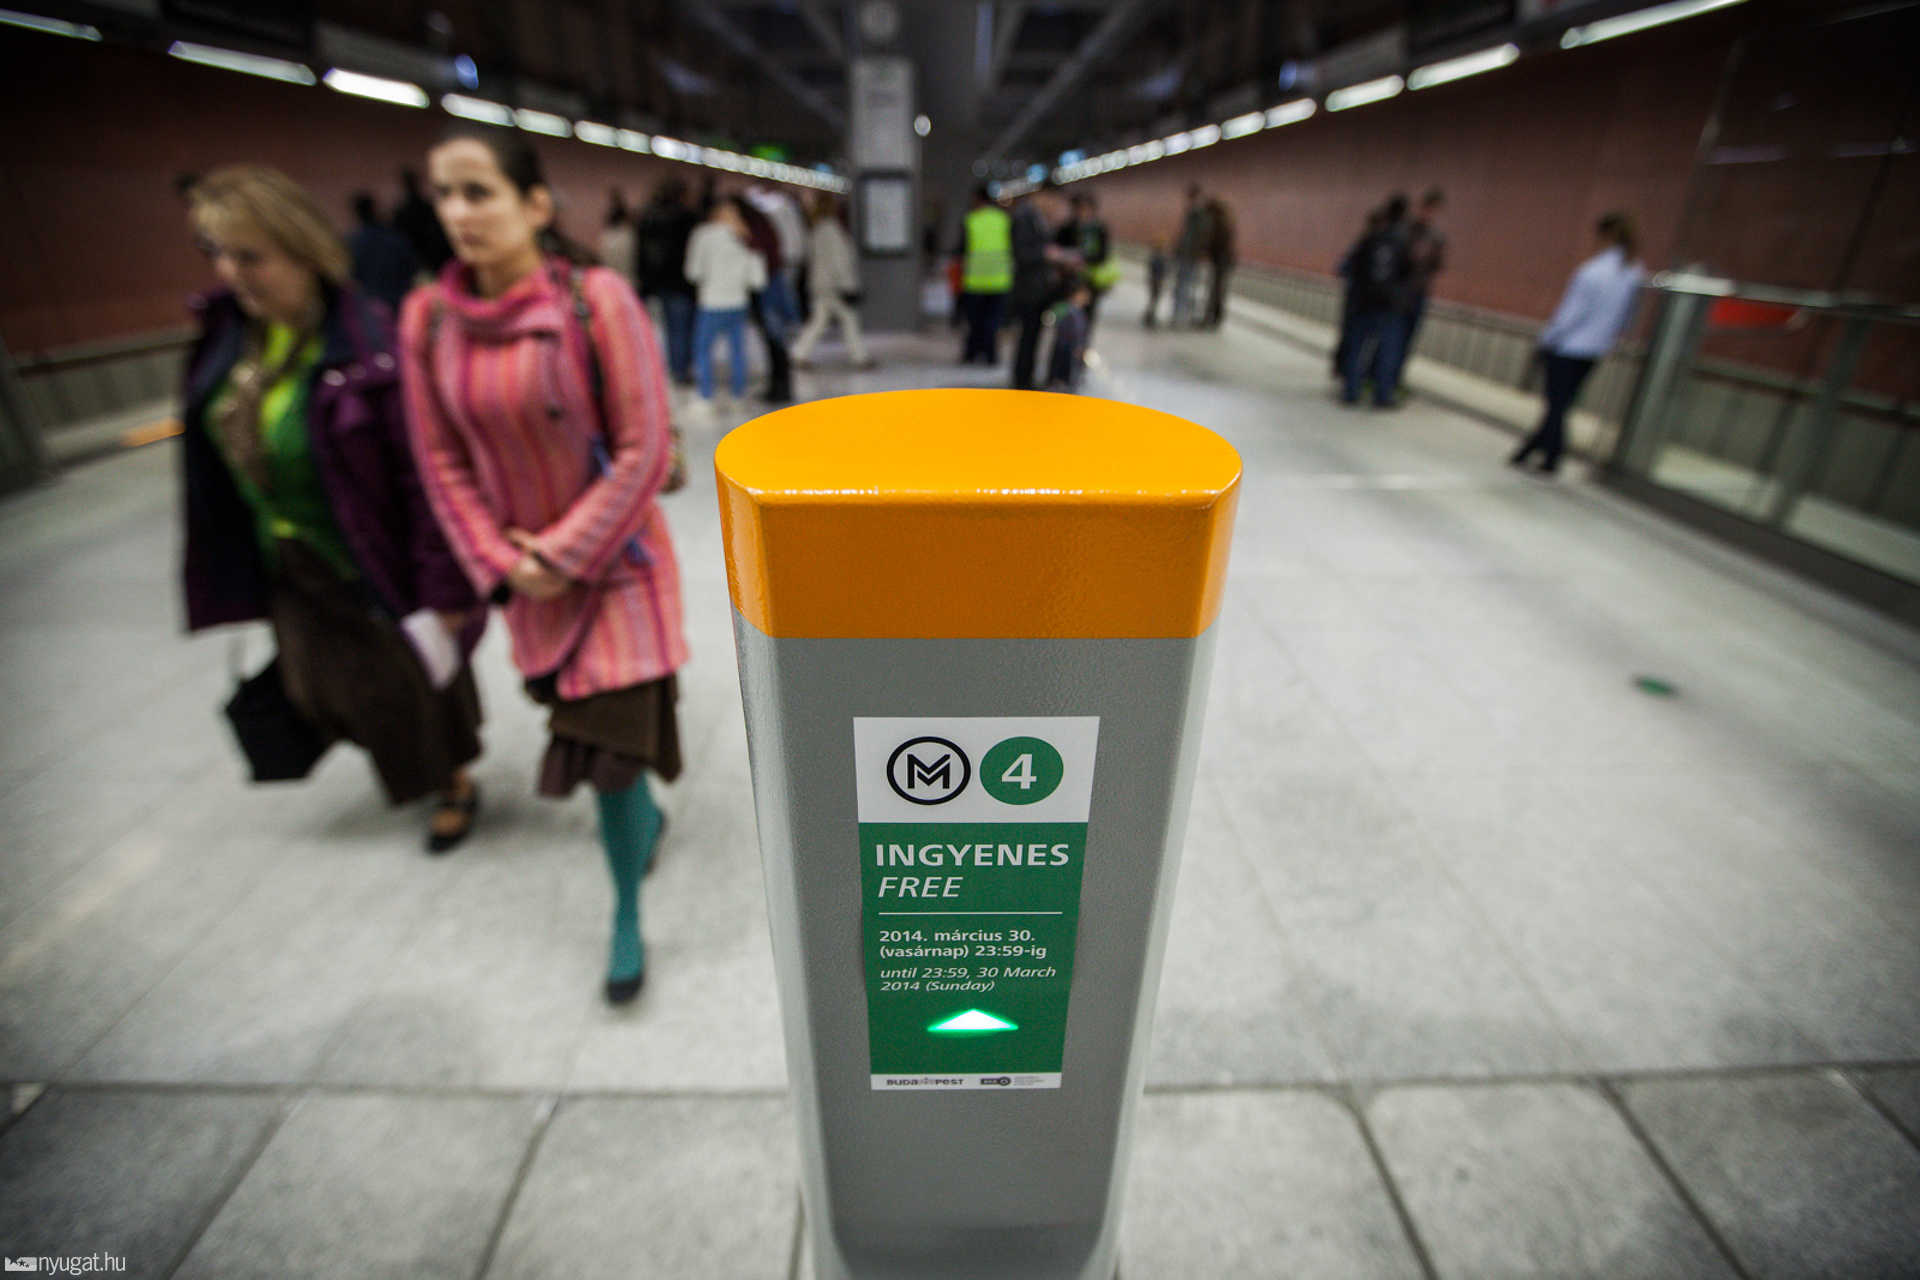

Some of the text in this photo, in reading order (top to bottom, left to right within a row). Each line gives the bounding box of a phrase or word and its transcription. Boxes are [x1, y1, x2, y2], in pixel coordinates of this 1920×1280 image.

[1001, 753, 1037, 789] 4
[876, 844, 1069, 866] INGYENES
[878, 877, 963, 898] FREE
[879, 929, 1036, 942] 2014. március 30.
[880, 945, 1047, 959] (vasárnap) 23:59-ig
[880, 967, 1057, 980] until 23:59, 30 March
[880, 981, 996, 993] 2014 (Sunday)
